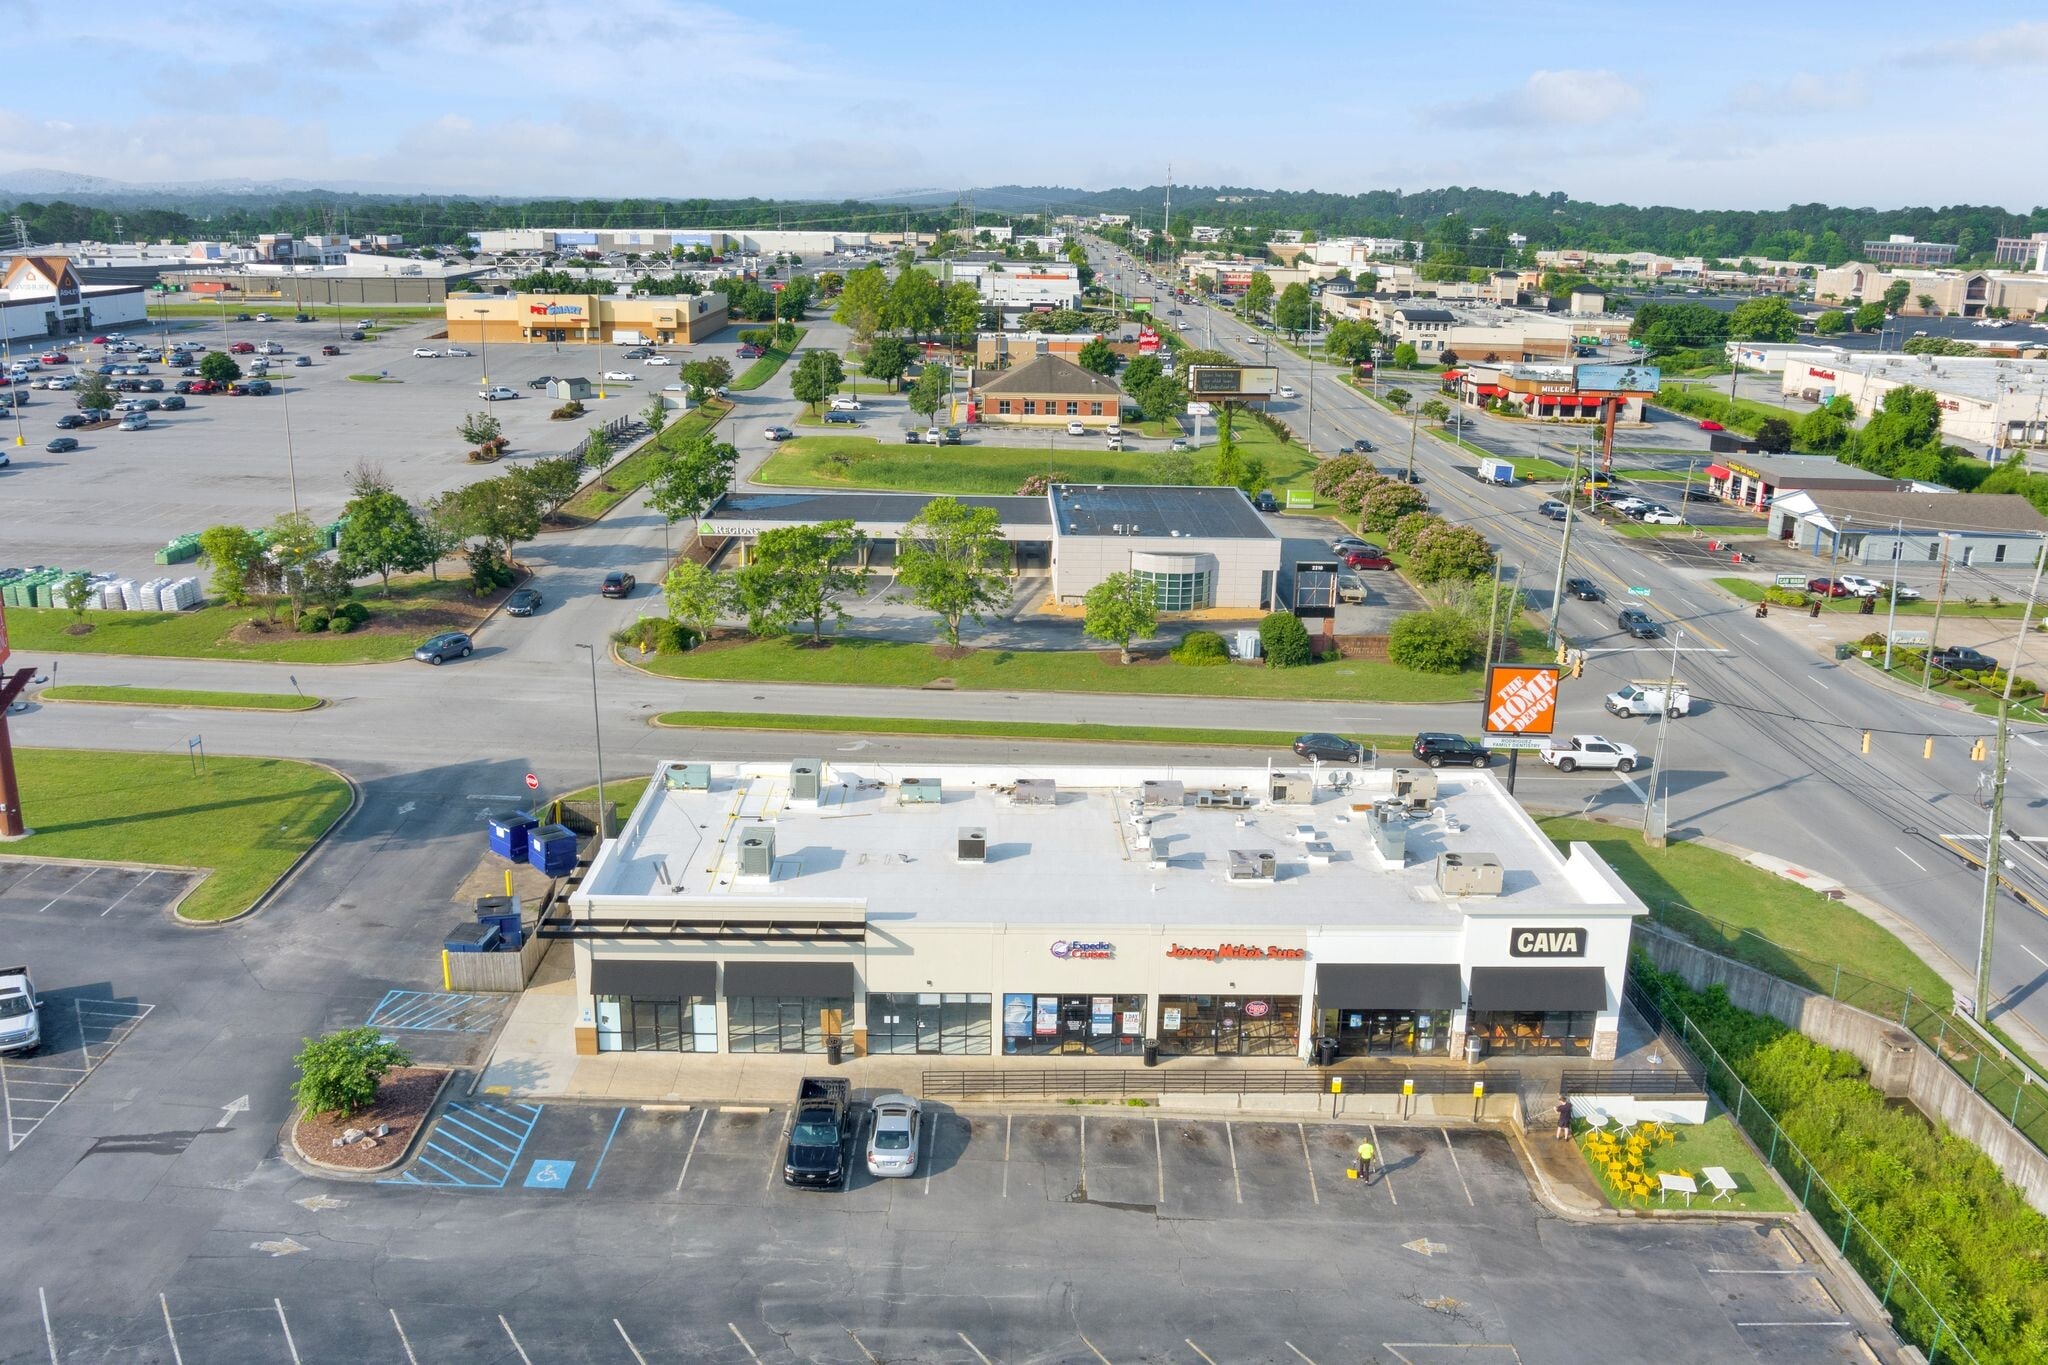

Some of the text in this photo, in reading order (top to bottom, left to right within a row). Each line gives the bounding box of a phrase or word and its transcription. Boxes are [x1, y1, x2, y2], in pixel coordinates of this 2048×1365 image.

[1497, 676, 1525, 700] THE
[1489, 670, 1557, 731] HOME
[1512, 692, 1555, 731] DEPOT
[1072, 941, 1110, 951] Expedia
[1166, 943, 1216, 960] Jersey
[1517, 932, 1578, 953] CAVA
[1071, 949, 1110, 959] Cruises
